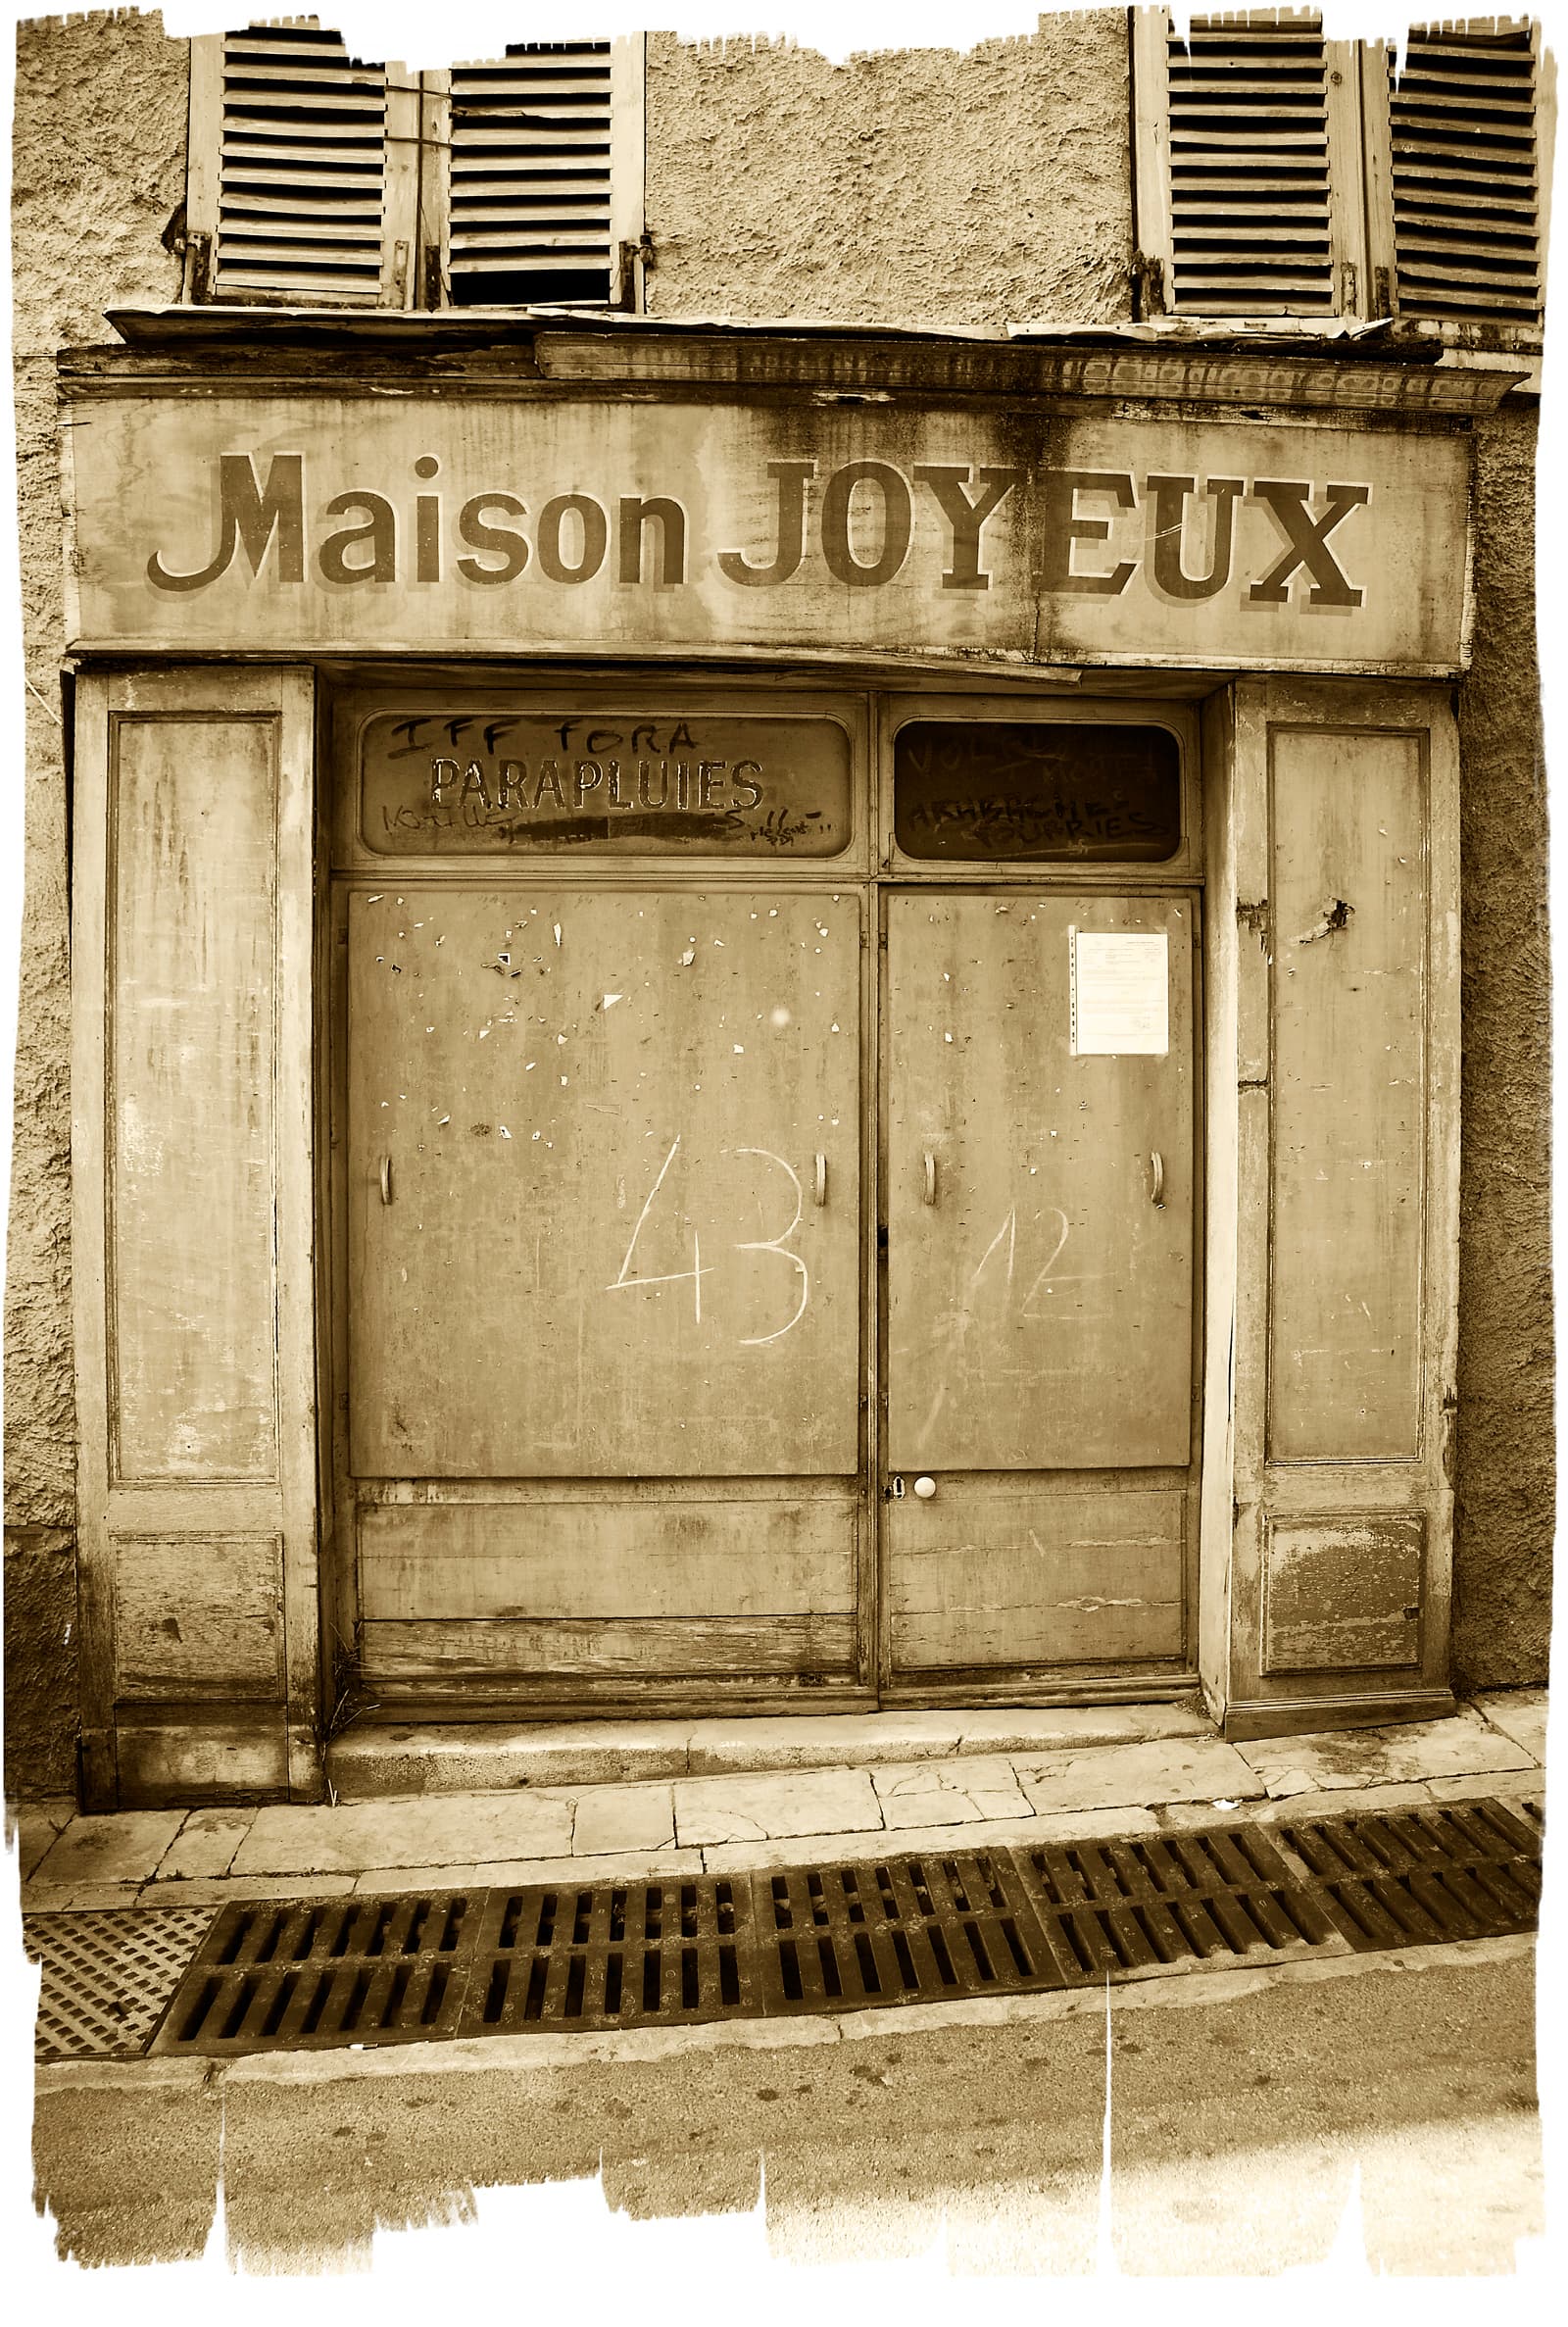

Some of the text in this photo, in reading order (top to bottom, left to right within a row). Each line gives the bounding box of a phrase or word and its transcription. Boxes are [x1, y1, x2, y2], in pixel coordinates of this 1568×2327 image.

[147, 451, 1371, 609] Maison JOYEUX
[429, 757, 765, 812] PARAPLUIES
[605, 1133, 808, 1347] 43
[969, 1206, 1114, 1320] 12
